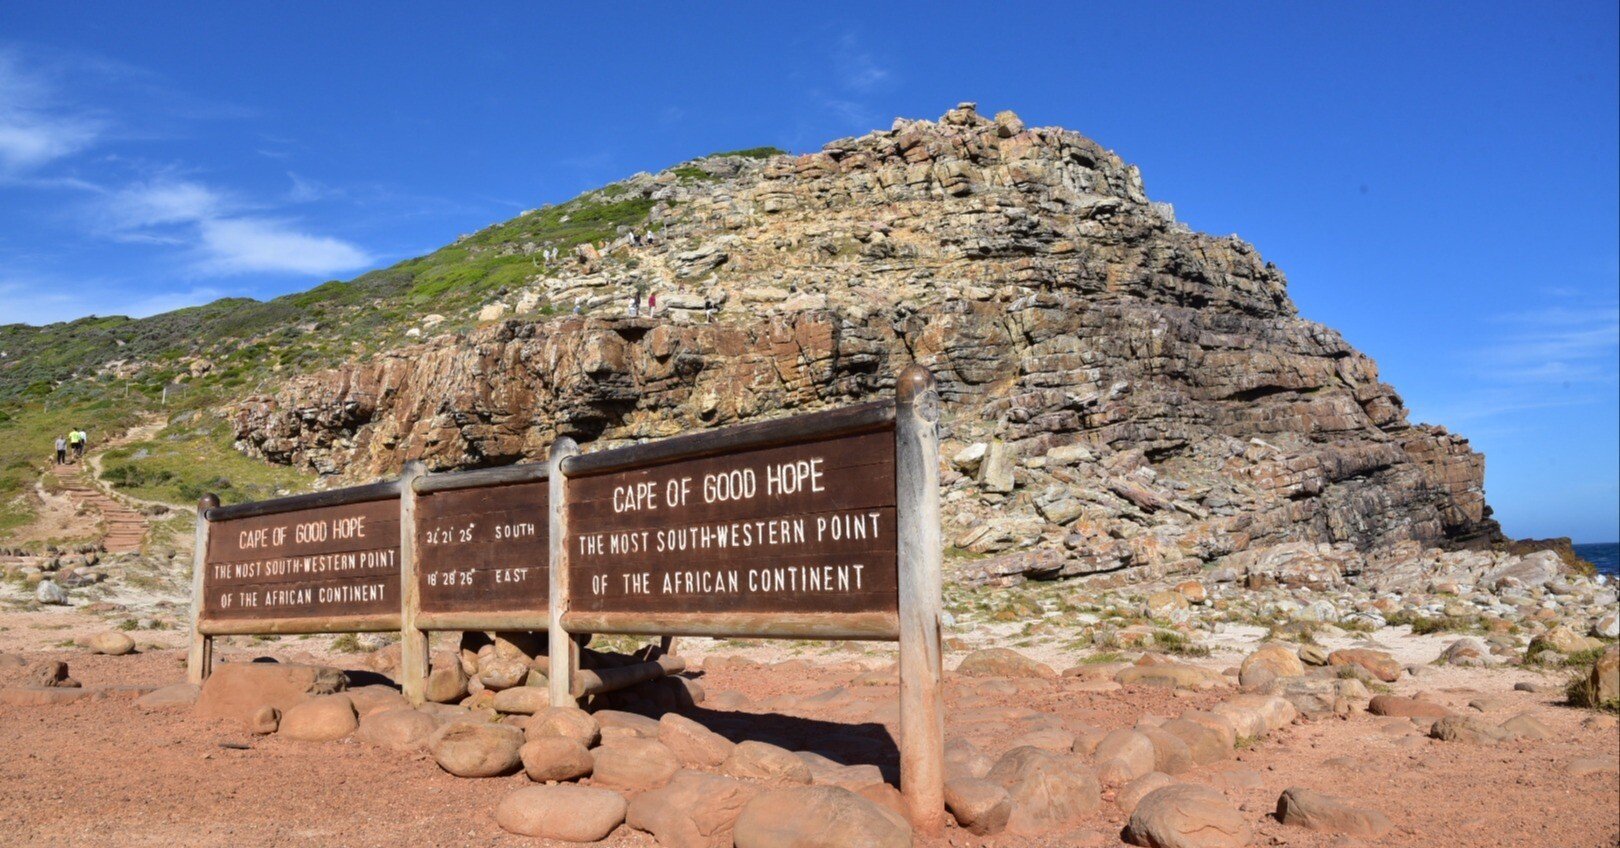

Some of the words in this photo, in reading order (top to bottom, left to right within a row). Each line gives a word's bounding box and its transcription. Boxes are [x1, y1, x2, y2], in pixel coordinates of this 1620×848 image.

[613, 482, 656, 513] CAPE
[666, 478, 691, 507] OF
[704, 469, 756, 503] GOOD
[767, 459, 824, 495] HOPE
[239, 528, 268, 549] CAPE
[273, 527, 287, 546] OF
[296, 521, 327, 543] GOOD
[333, 516, 365, 539] HOPE
[496, 524, 534, 539] SOUTH
[580, 535, 603, 555] THE
[611, 532, 648, 554] MOST
[657, 519, 804, 552] SOUTH-WESTERN
[817, 514, 880, 541] POINT
[215, 565, 231, 579] THE
[236, 562, 261, 577] MOST
[266, 554, 355, 575] SOUTH-WESTERN
[360, 550, 394, 568] POINT
[496, 569, 528, 583] EAST
[592, 575, 607, 595] OF
[623, 573, 649, 593] THE
[663, 571, 738, 593] AFRICAN
[749, 565, 863, 592] CONTINENT
[221, 594, 232, 608] OF
[240, 592, 257, 606] THE
[265, 589, 311, 605] AFRICAN
[319, 585, 384, 603] CONTINENT
